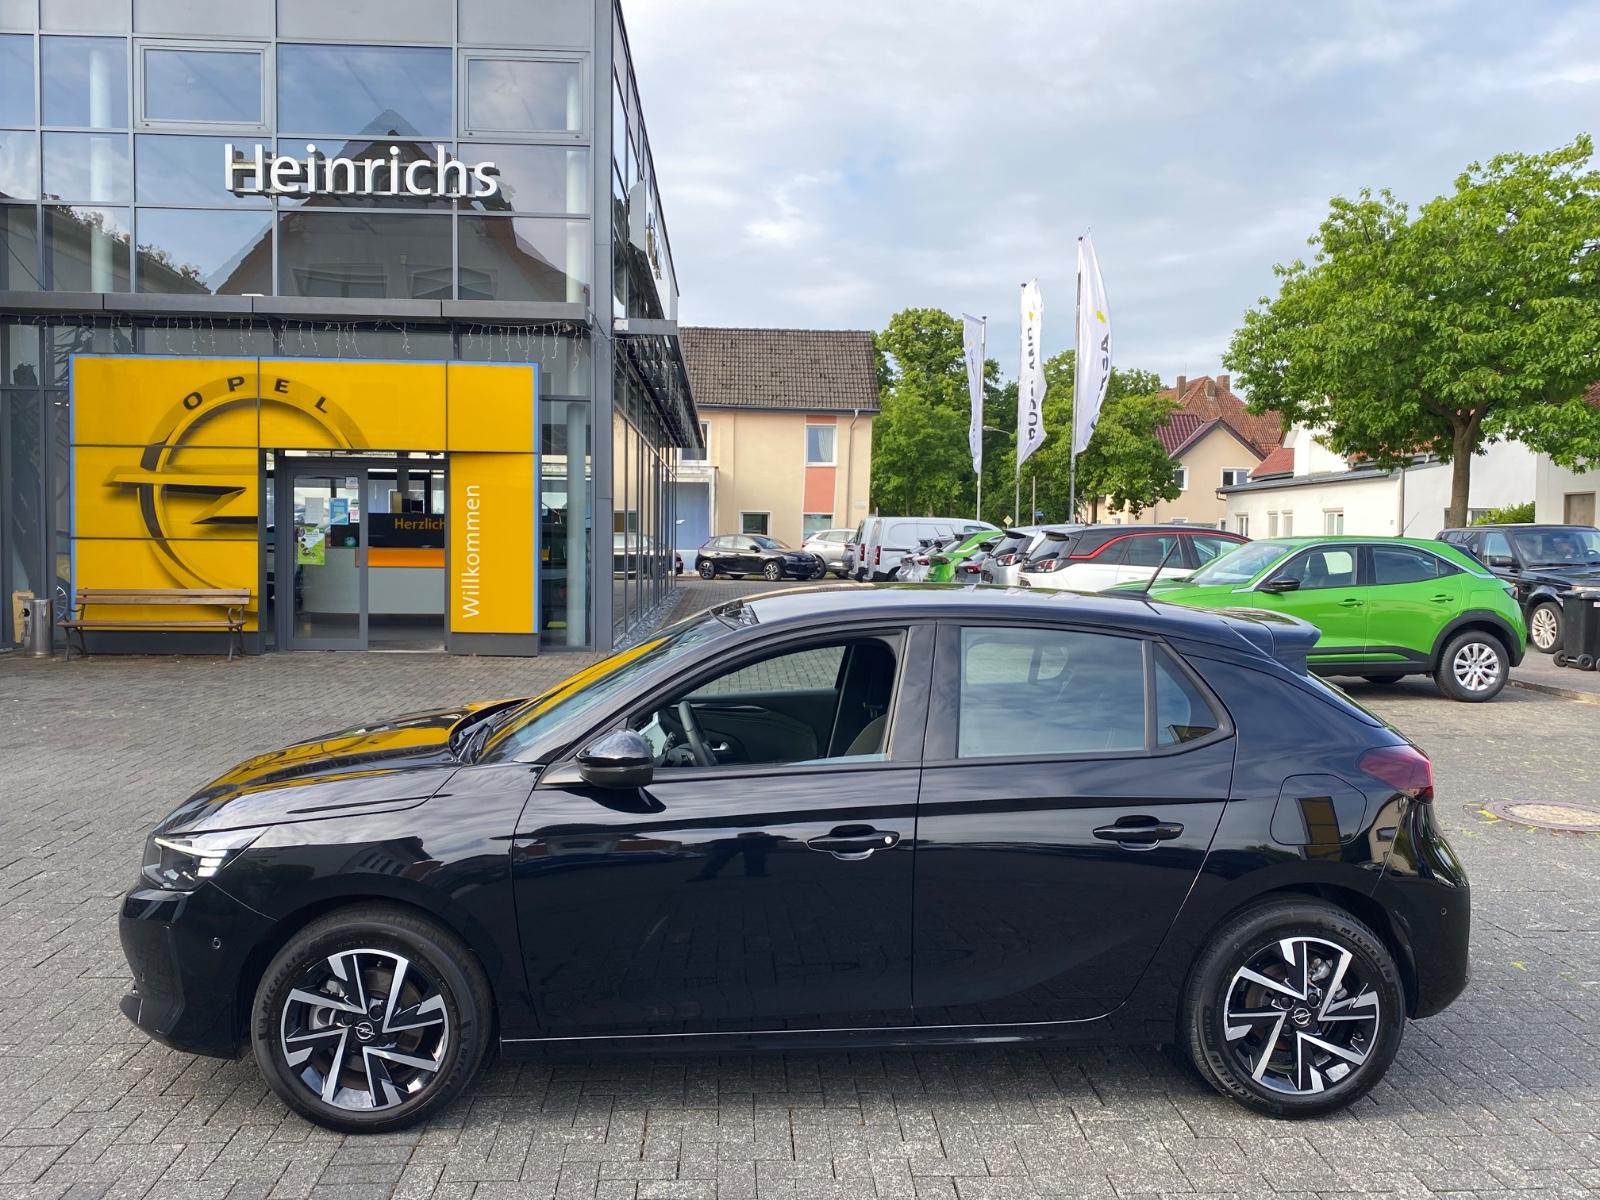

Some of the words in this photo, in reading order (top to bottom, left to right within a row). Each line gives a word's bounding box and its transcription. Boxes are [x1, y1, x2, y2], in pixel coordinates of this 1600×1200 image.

[224, 143, 498, 197] Heinrichs
[183, 376, 328, 414] OPEL
[461, 485, 481, 620] Willkommen
